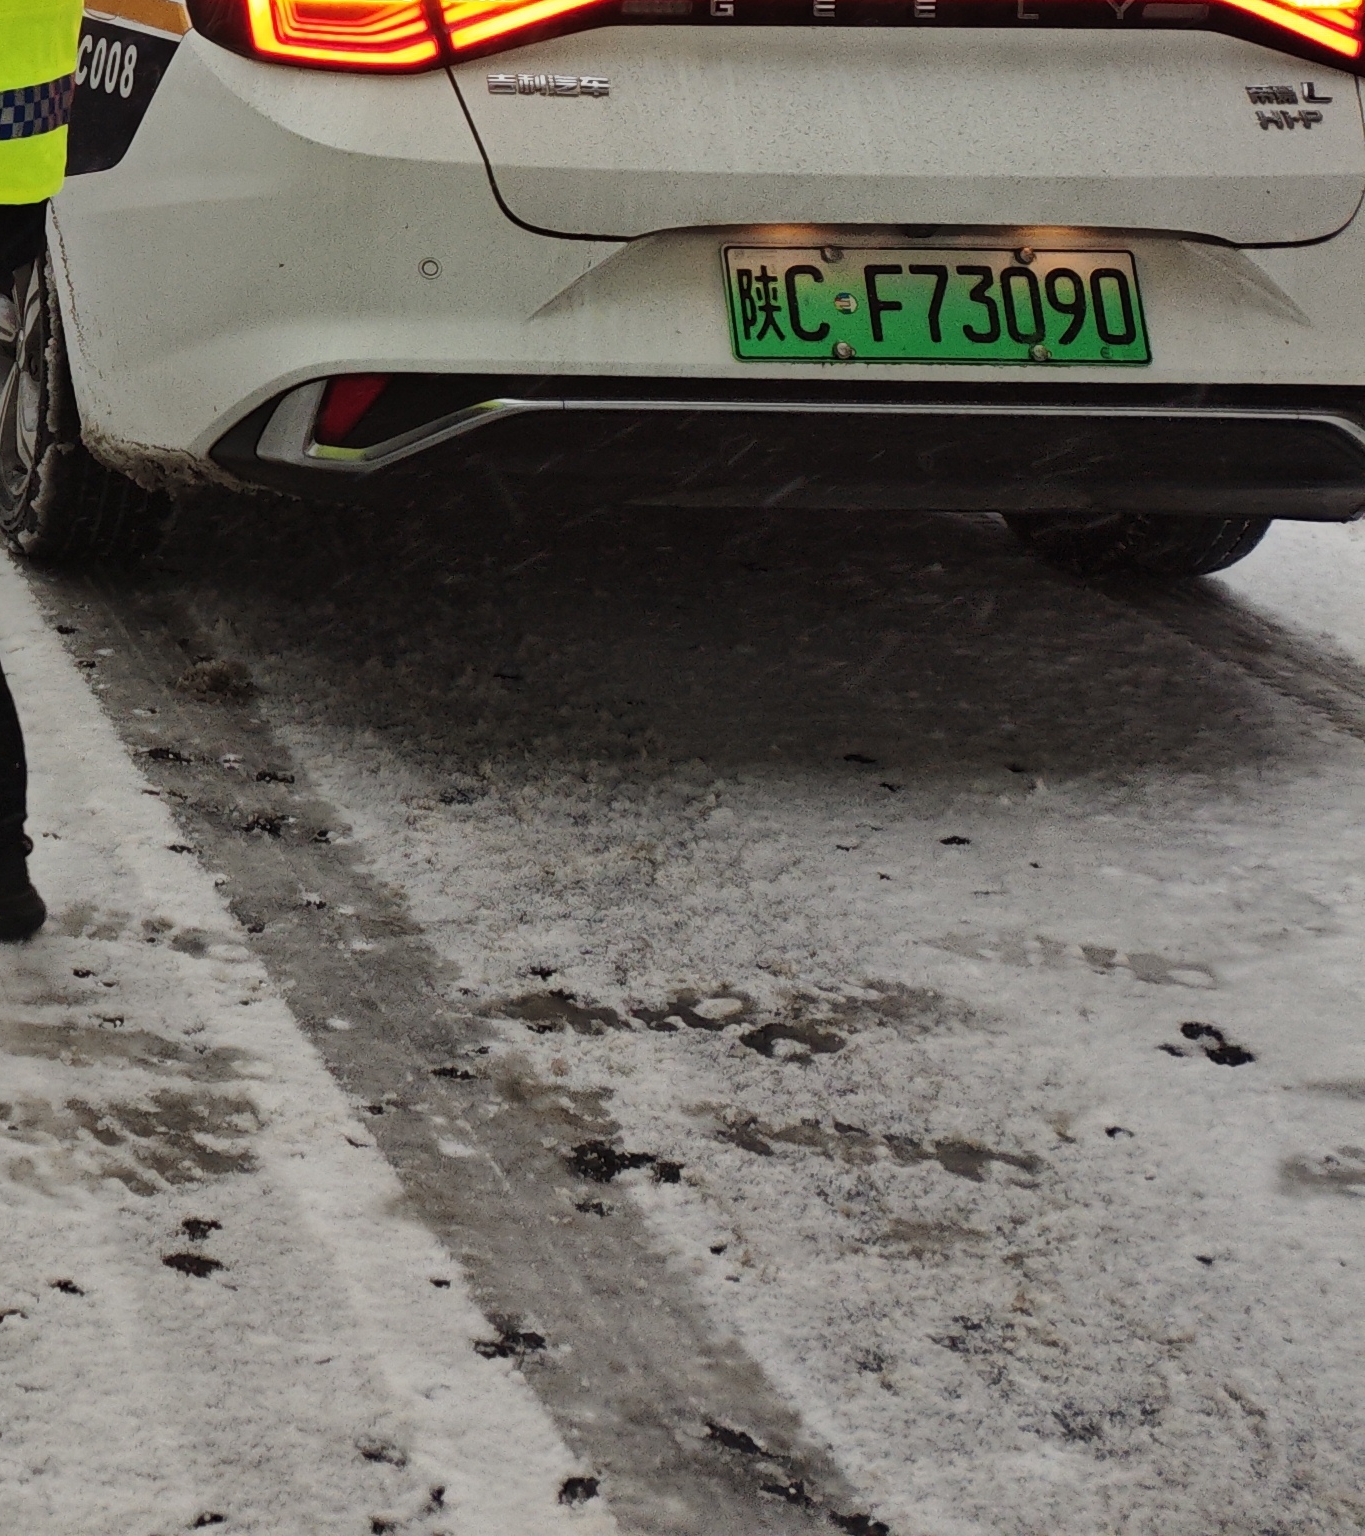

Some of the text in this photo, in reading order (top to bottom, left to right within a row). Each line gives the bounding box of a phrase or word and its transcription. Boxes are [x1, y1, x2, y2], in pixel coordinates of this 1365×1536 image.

[486, 73, 610, 98] 吉利汽车
[864, 264, 1137, 345] F73090
